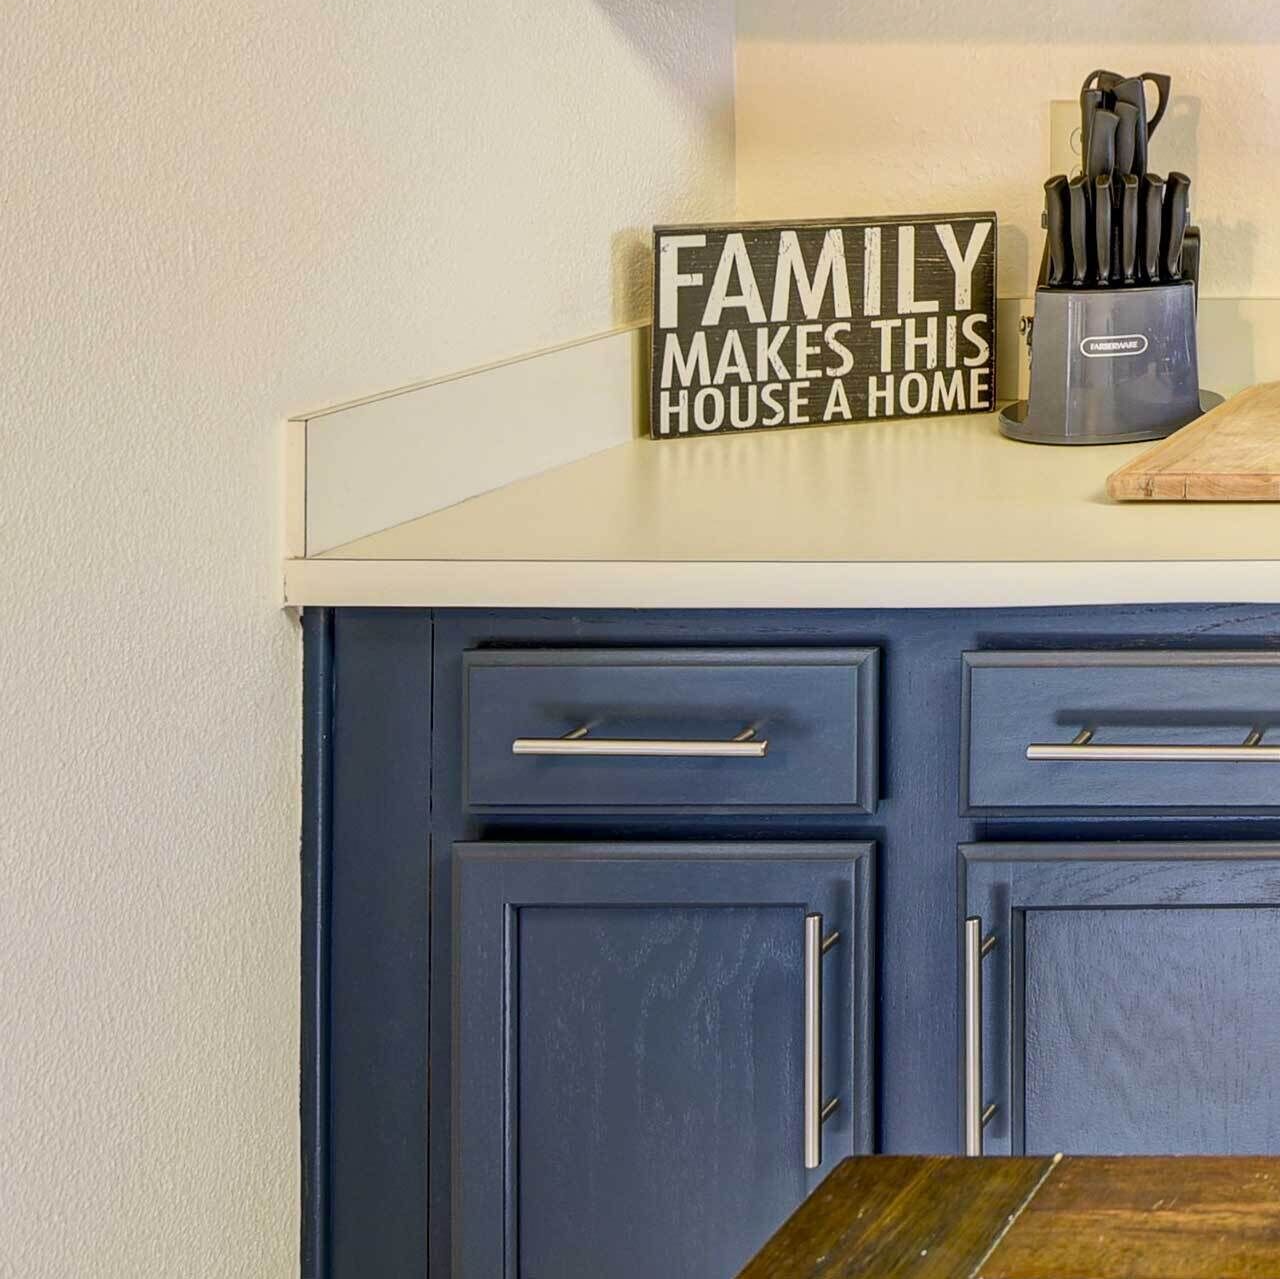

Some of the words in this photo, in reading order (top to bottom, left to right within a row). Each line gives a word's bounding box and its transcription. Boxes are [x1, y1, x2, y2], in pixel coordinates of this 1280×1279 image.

[659, 222, 993, 329] FAMILY
[660, 322, 854, 389] MAKES
[870, 313, 990, 373] THIS
[659, 380, 811, 434] HOUSE
[823, 378, 853, 421] A
[868, 368, 990, 418] HOME
